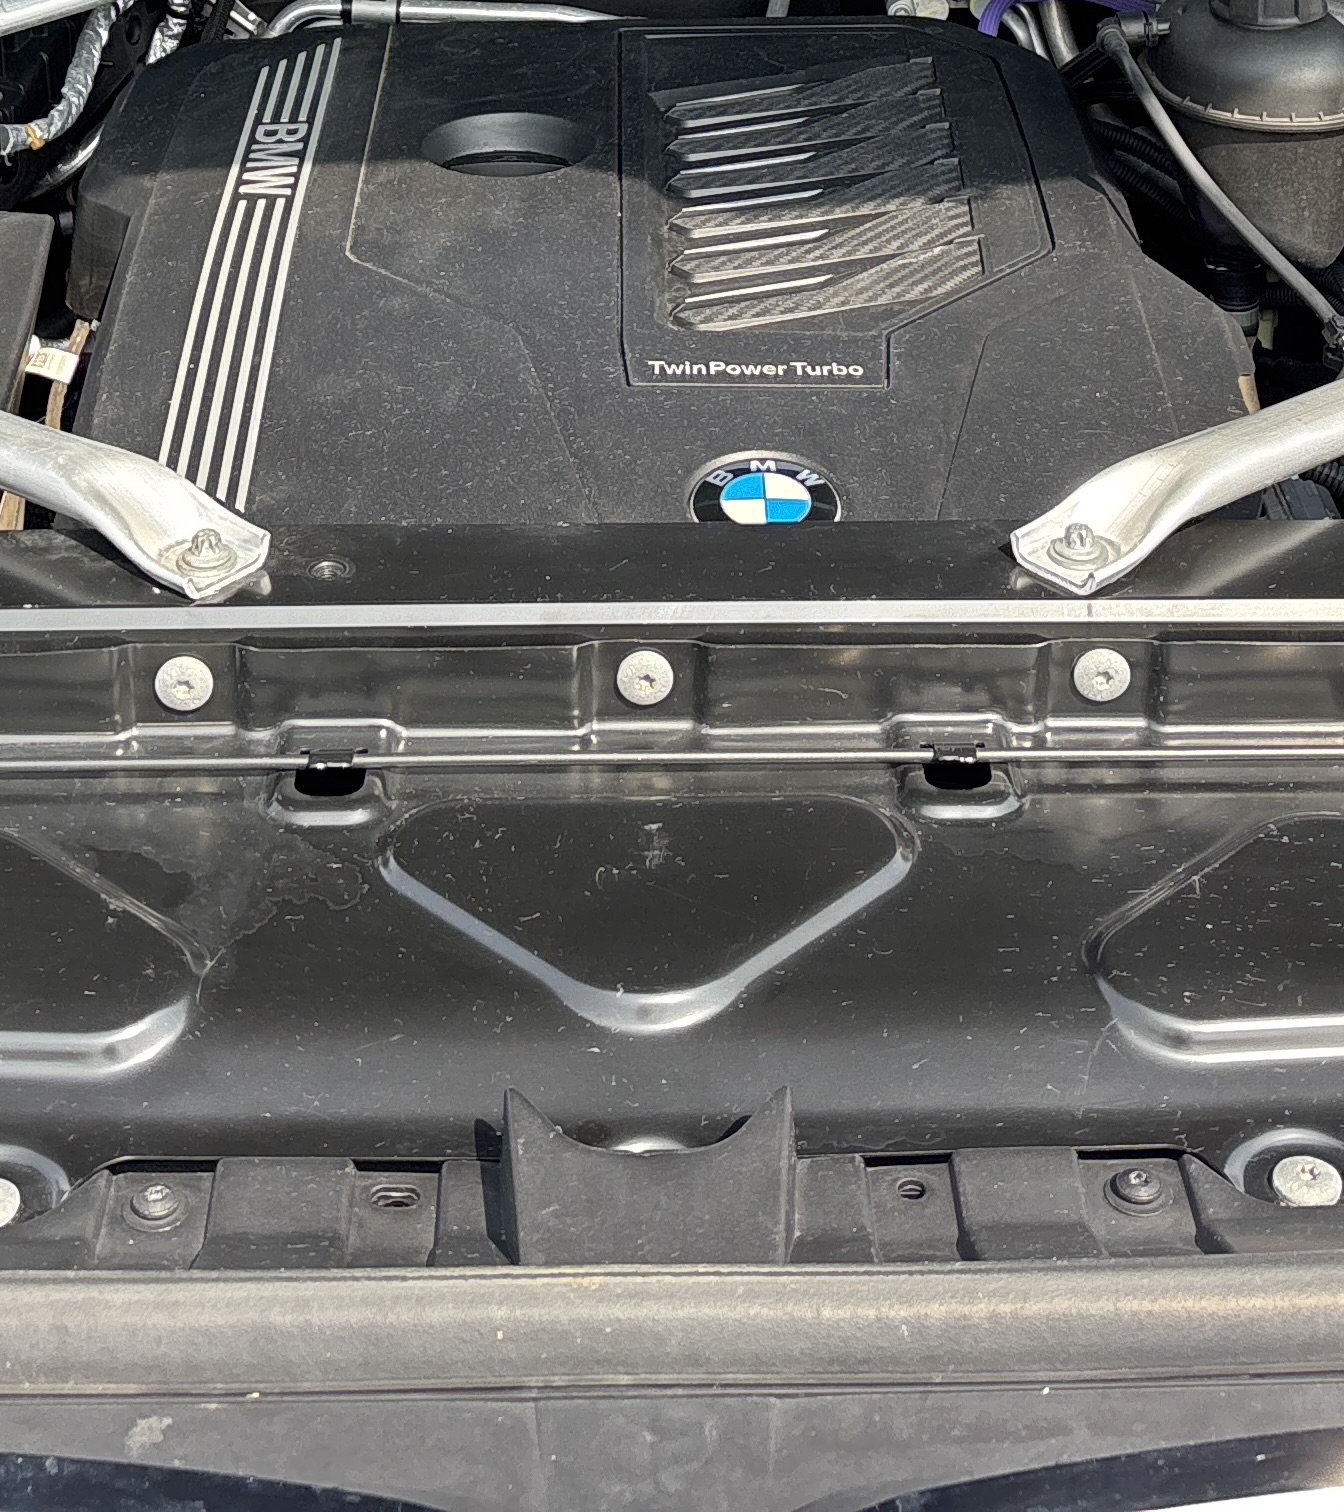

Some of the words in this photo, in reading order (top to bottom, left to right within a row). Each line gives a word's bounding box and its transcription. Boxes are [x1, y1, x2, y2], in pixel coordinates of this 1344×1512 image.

[238, 122, 308, 195] BMW
[789, 361, 864, 376] Turbo
[704, 459, 825, 487] BMW
